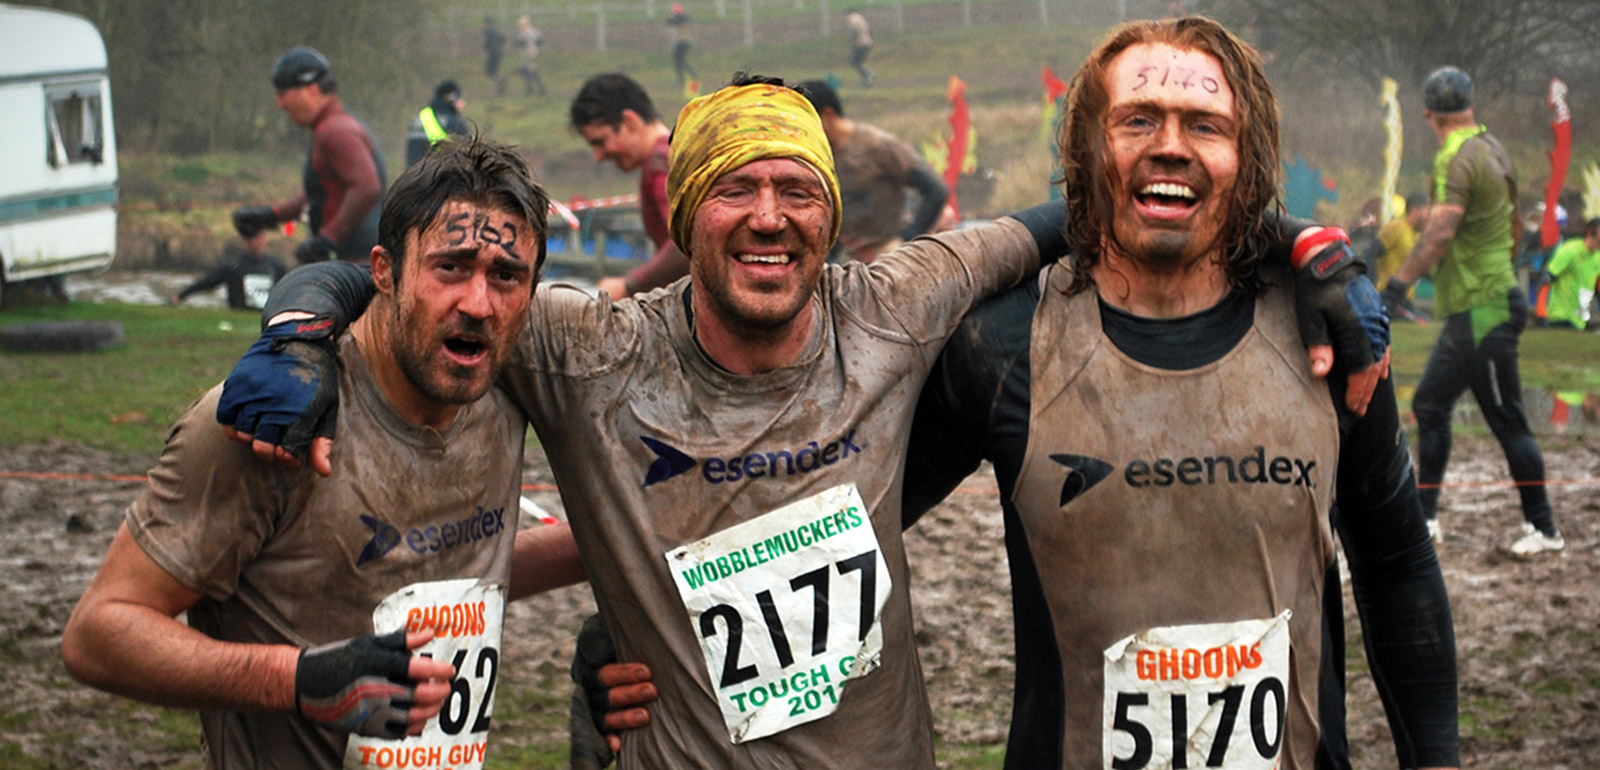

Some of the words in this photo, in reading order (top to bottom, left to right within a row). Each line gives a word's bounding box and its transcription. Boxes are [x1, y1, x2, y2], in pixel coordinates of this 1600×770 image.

[1132, 66, 1219, 94] 5170
[446, 212, 520, 260] 5162
[703, 429, 862, 485] esendex
[1124, 446, 1316, 488] esendex
[406, 506, 505, 554] esendex
[682, 506, 863, 590] WOBBLEMUCKERS
[405, 600, 486, 638] GHOONS
[700, 549, 877, 690] 2177
[1136, 640, 1264, 681] GHOONS
[420, 647, 499, 736] 62
[730, 664, 831, 713] TOUGH
[788, 680, 846, 718] 201
[1112, 676, 1286, 770] 5170
[358, 745, 442, 768] TOUGH
[449, 742, 487, 766] GUY
